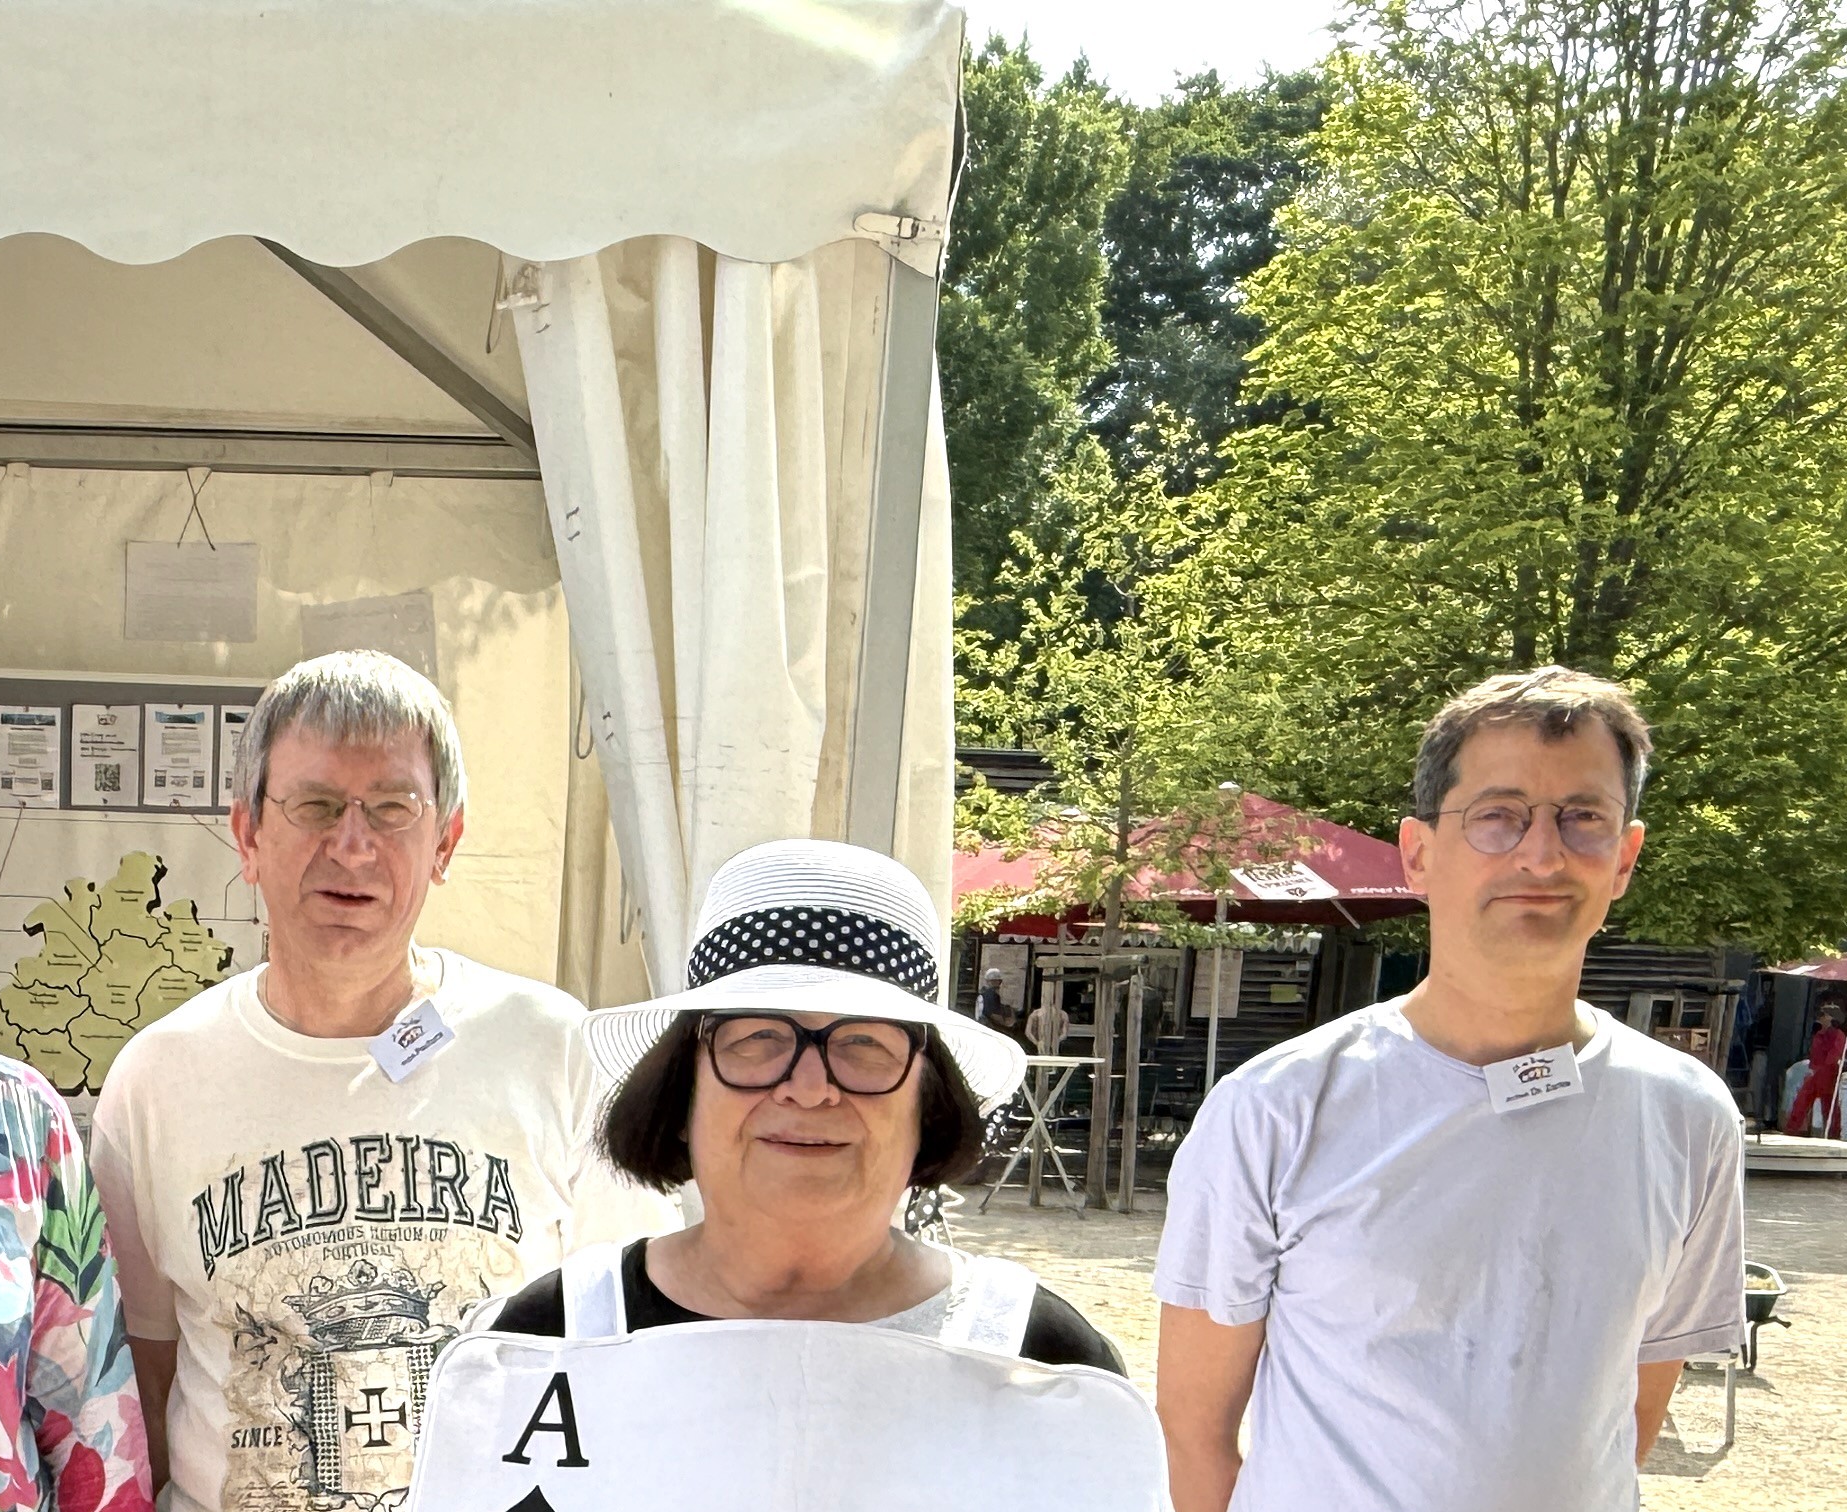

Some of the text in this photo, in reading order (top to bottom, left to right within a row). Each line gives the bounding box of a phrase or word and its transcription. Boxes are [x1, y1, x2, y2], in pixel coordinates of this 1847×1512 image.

[192, 1132, 524, 1281] MADEIRA
[231, 1425, 284, 1449] SINCE
[502, 1371, 590, 1468] A
